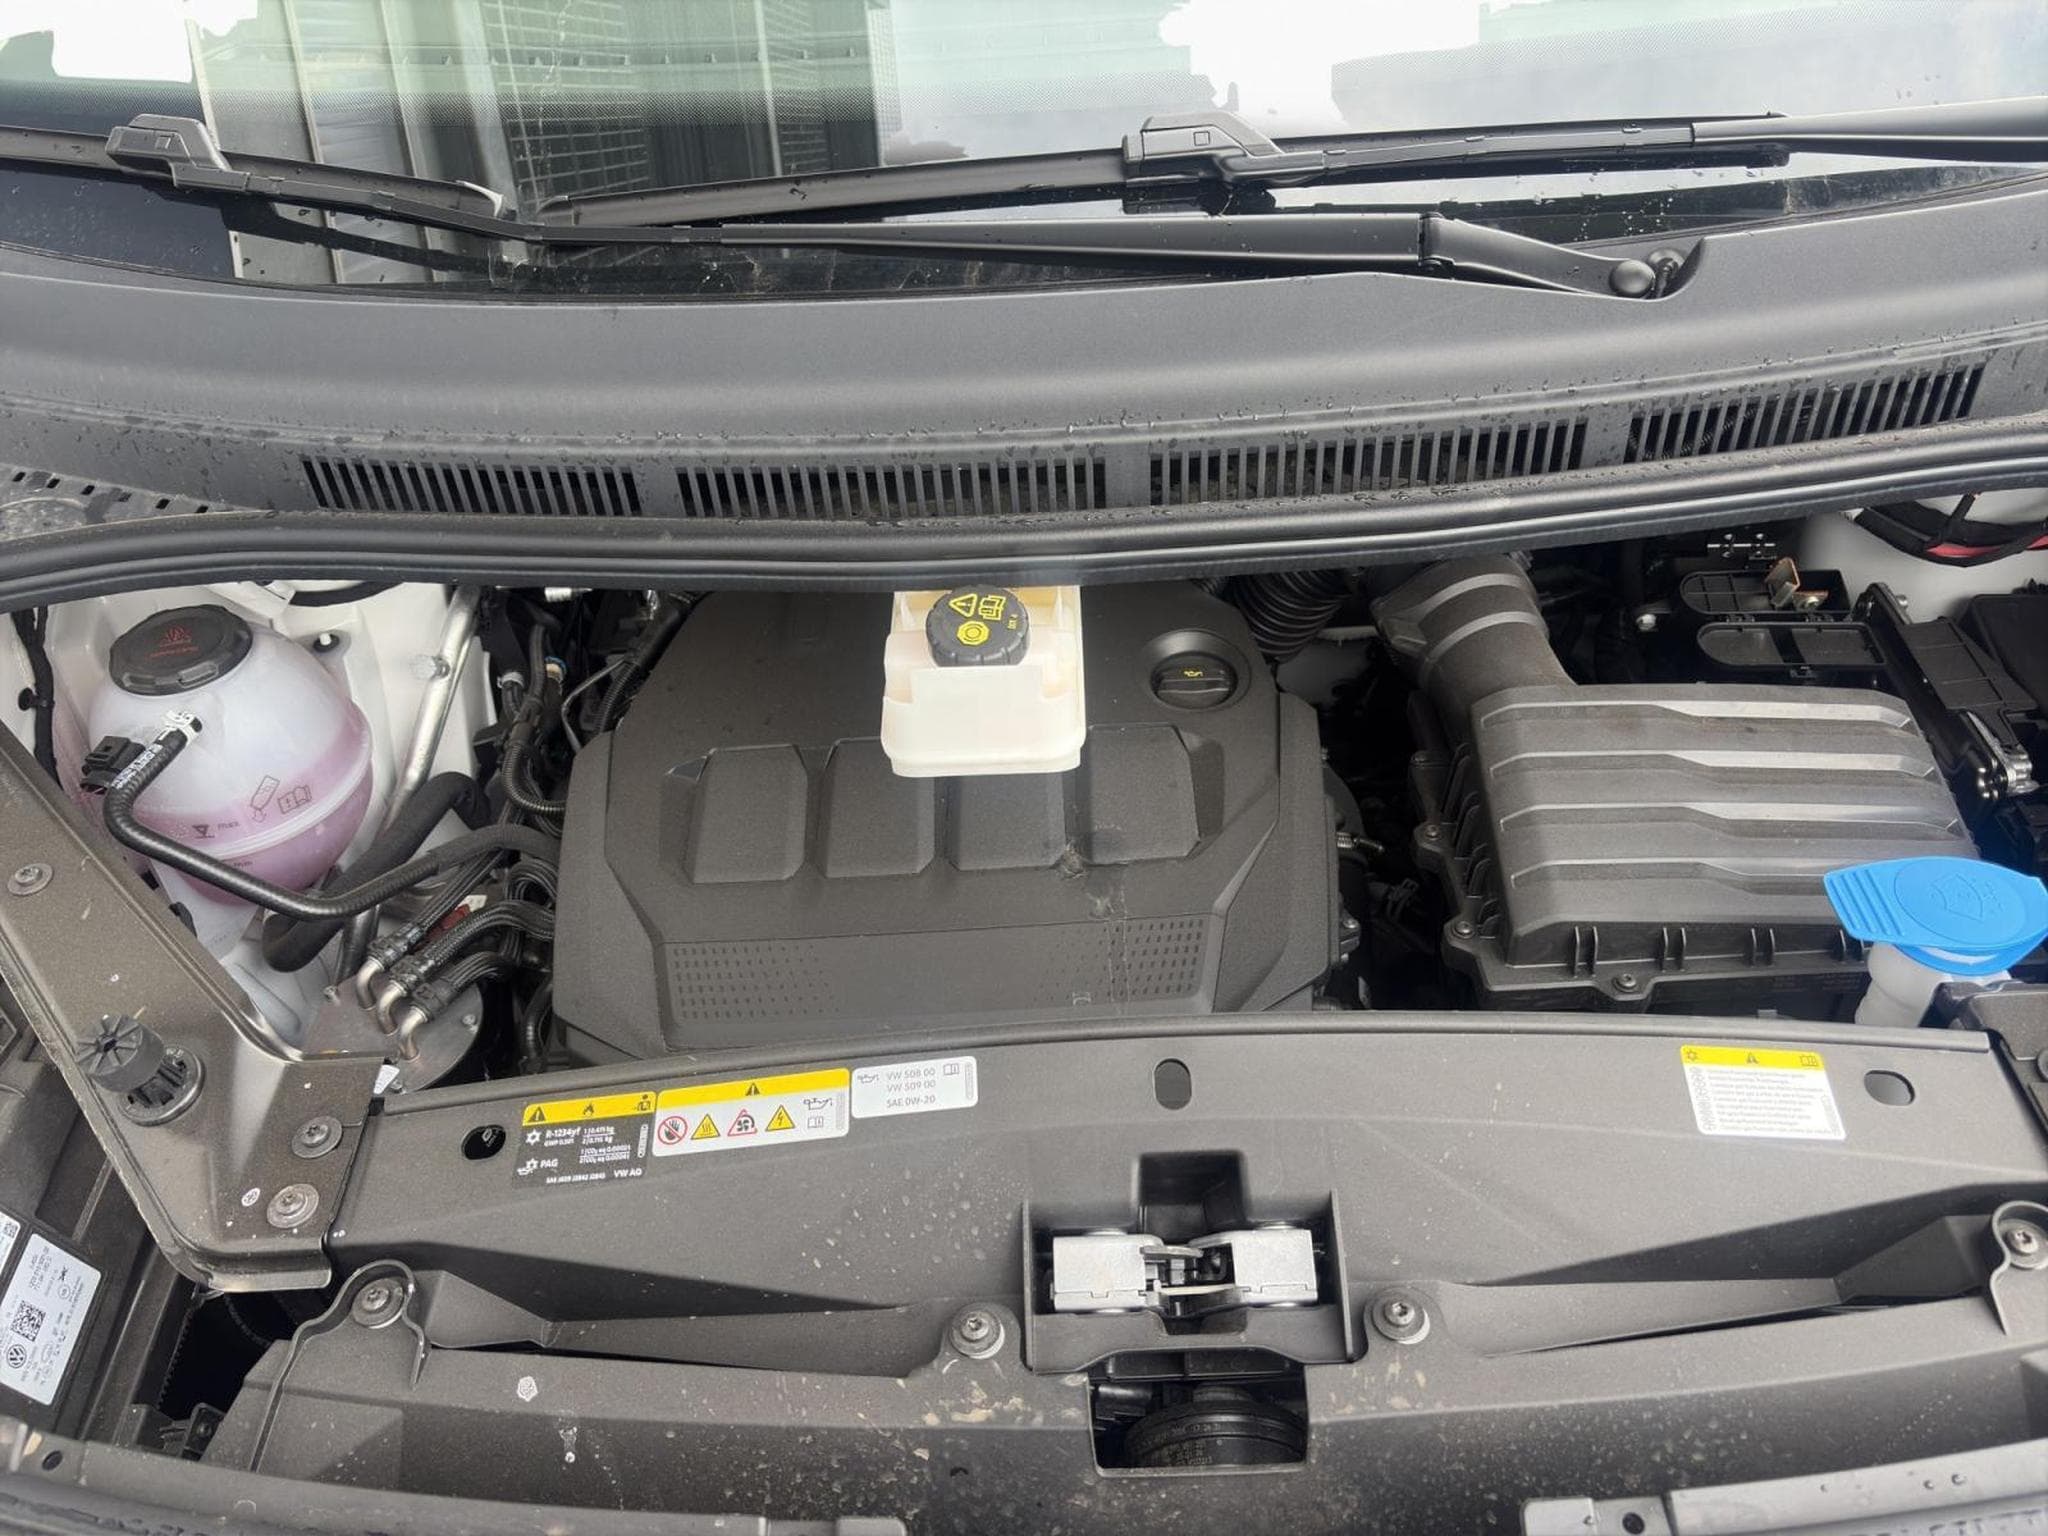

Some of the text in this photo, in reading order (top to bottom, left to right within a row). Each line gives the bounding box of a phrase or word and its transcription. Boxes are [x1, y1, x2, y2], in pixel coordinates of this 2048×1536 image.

[887, 1067, 936, 1081] VW 508 00
[886, 1083, 902, 1092] VW
[923, 1079, 936, 1088] 00
[886, 1098, 904, 1108] SAE
[540, 1158, 559, 1168] PAG
[613, 1169, 628, 1178] VW
